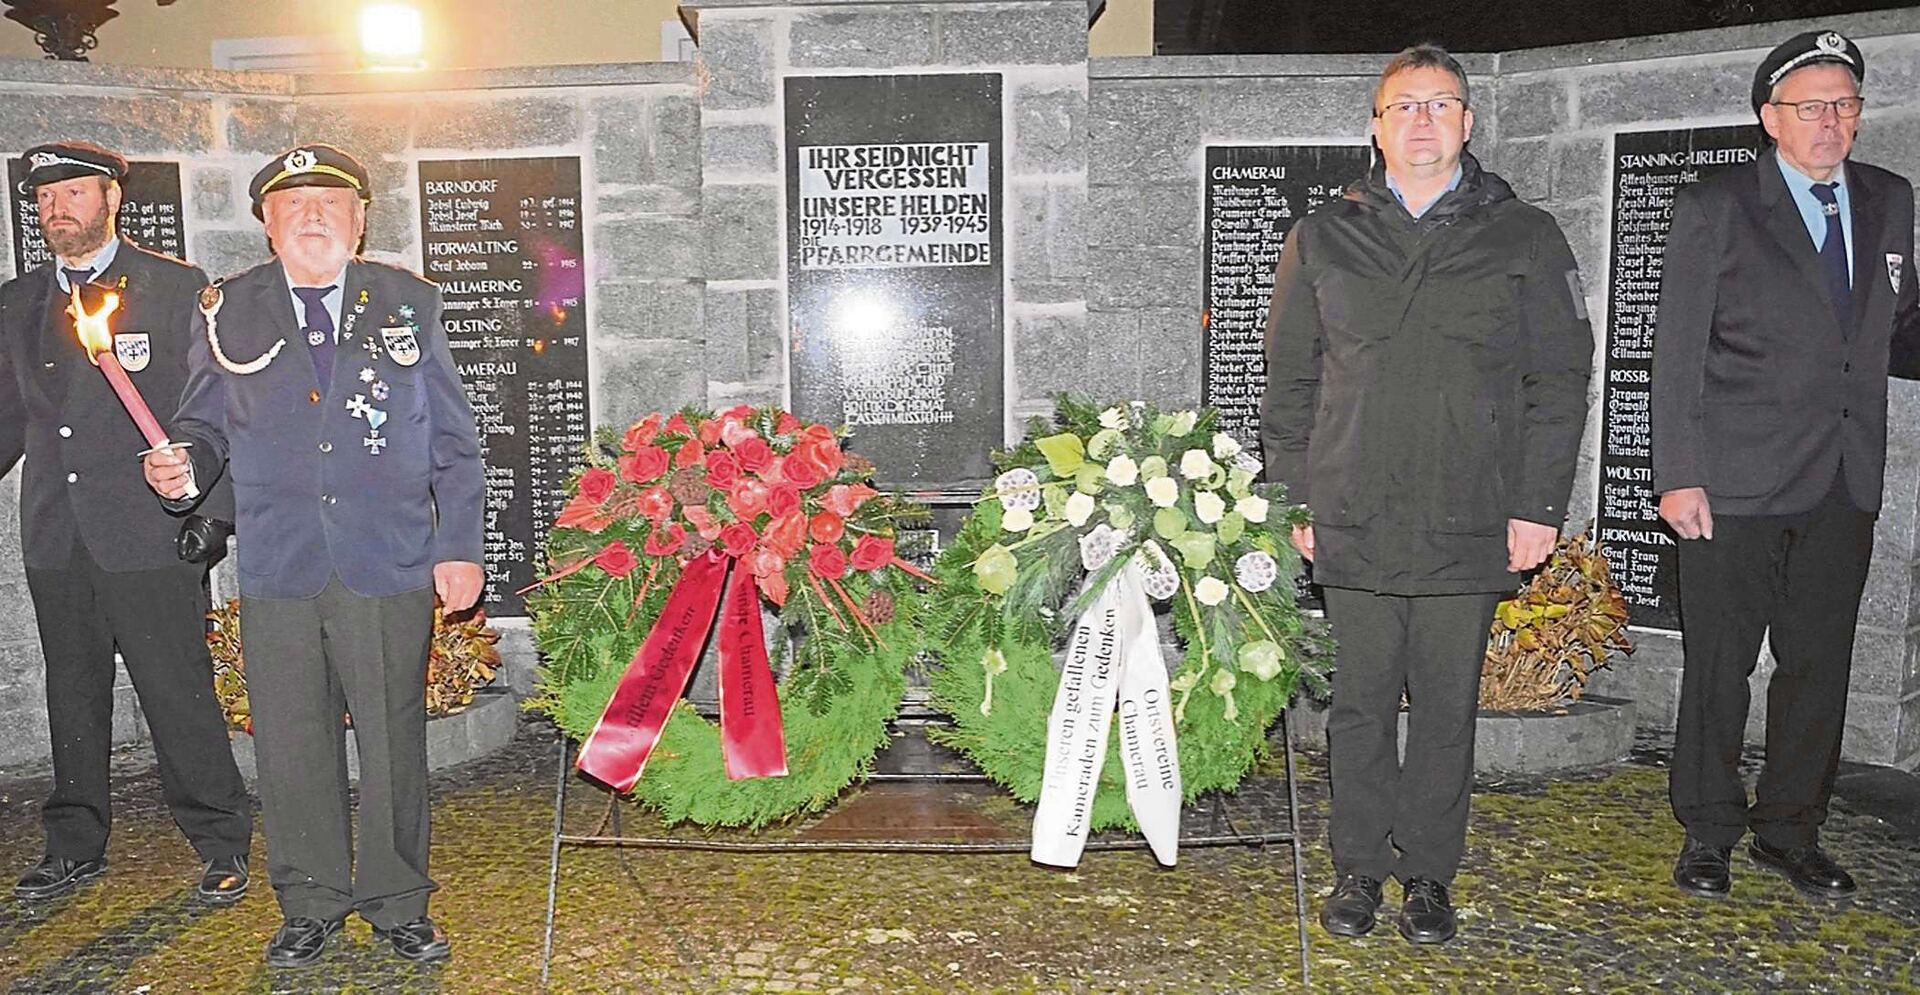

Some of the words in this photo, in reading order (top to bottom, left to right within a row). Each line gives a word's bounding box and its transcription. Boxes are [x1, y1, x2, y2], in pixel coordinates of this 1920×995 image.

[809, 149, 850, 168] IHR
[854, 147, 905, 167] SEID
[906, 145, 978, 166] NICHT
[1620, 148, 1757, 168] STANNING-URLEITEN
[824, 167, 967, 190] VERGESSEN
[1212, 167, 1285, 180] CHAMERAU
[803, 196, 895, 217] UNSERE
[901, 193, 987, 215] HELDEN
[802, 218, 882, 236] 1914-1918
[900, 216, 987, 234] 1939-1945
[802, 236, 821, 246] DIE
[802, 243, 989, 265] PFARRGEMEINDE
[457, 362, 517, 376] AMERAU
[1610, 370, 1650, 383] ROSSB
[1064, 625, 1090, 713] gefallenen
[1067, 738, 1097, 837] Kameraden
[1091, 608, 1115, 688] Gedenken
[1123, 699, 1148, 790] Chamerau
[1143, 688, 1174, 791] Ortsvereine
